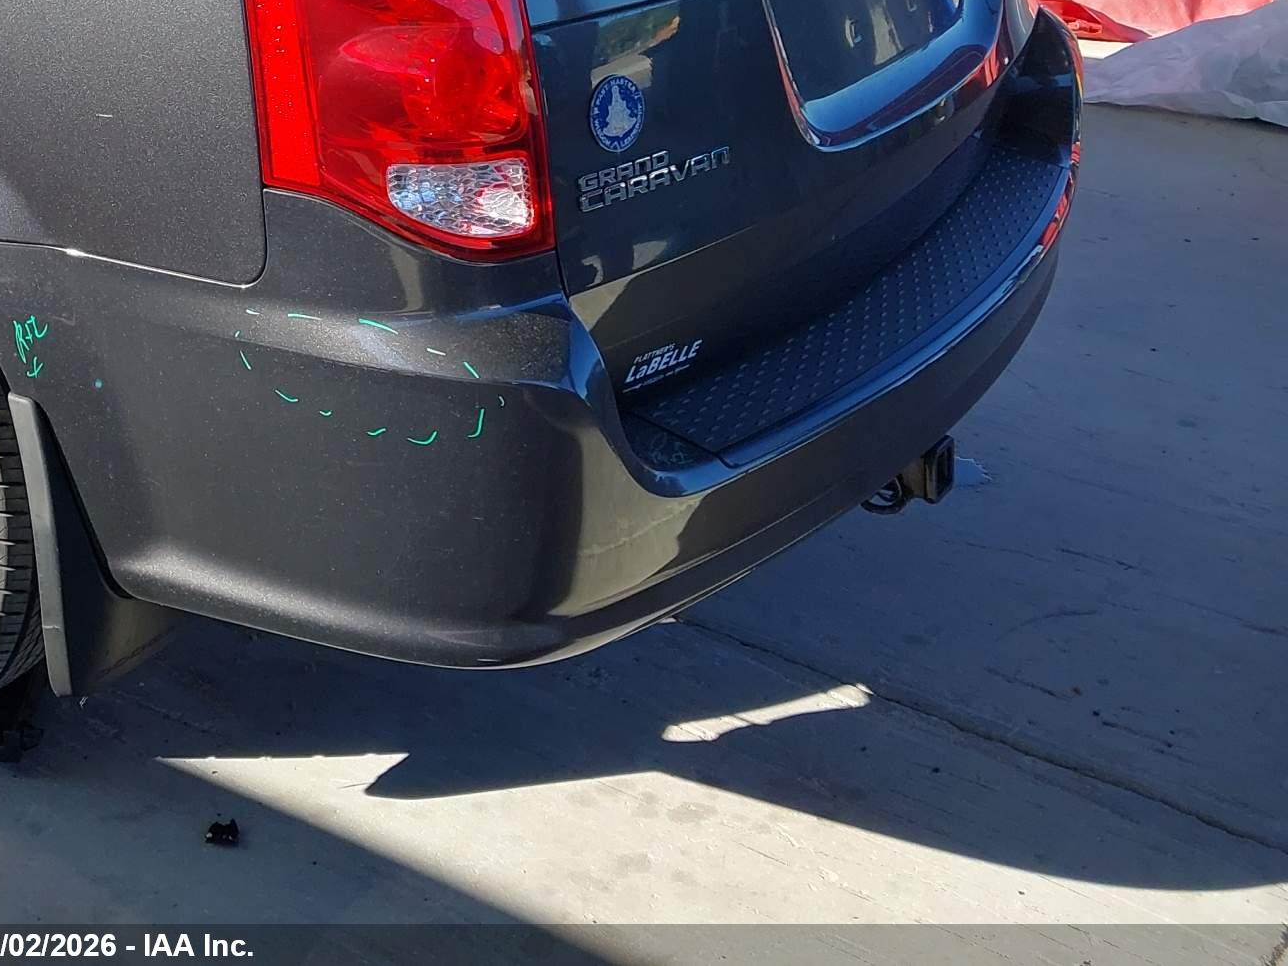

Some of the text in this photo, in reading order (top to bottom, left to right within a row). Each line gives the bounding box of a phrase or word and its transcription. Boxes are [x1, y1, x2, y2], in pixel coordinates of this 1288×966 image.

[578, 150, 670, 192] GRAND
[579, 145, 731, 213] CARAVAN
[624, 339, 703, 384] LaBELLE
